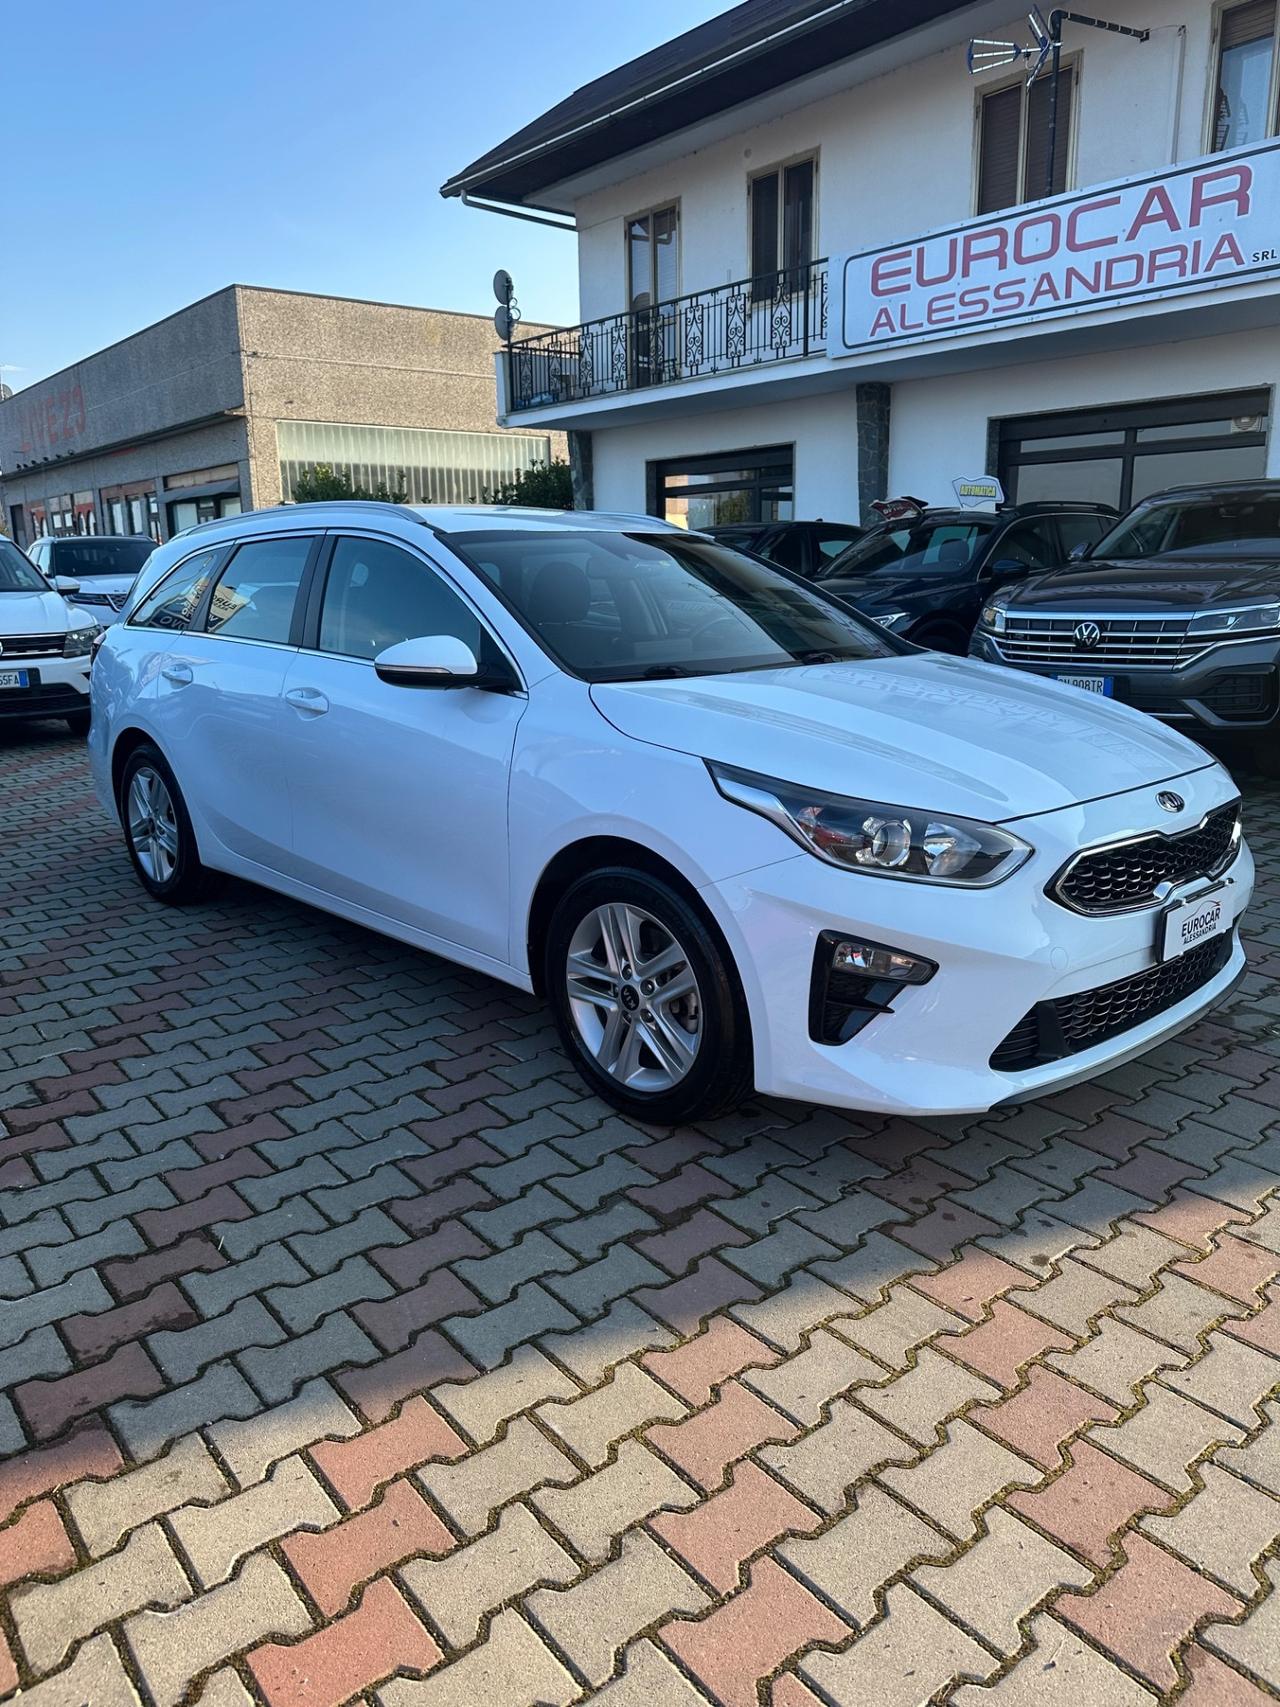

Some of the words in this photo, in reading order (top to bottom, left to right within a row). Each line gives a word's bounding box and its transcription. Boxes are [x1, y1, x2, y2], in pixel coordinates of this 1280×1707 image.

[871, 165, 1253, 297] EUROCAR
[870, 232, 1245, 337] ALESSANDRIA
[1252, 249, 1278, 263] SRL
[960, 485, 996, 497] AUTOMATICA
[1181, 907, 1221, 938] EUROCAR
[1183, 922, 1217, 946] ALESSANDRIA
